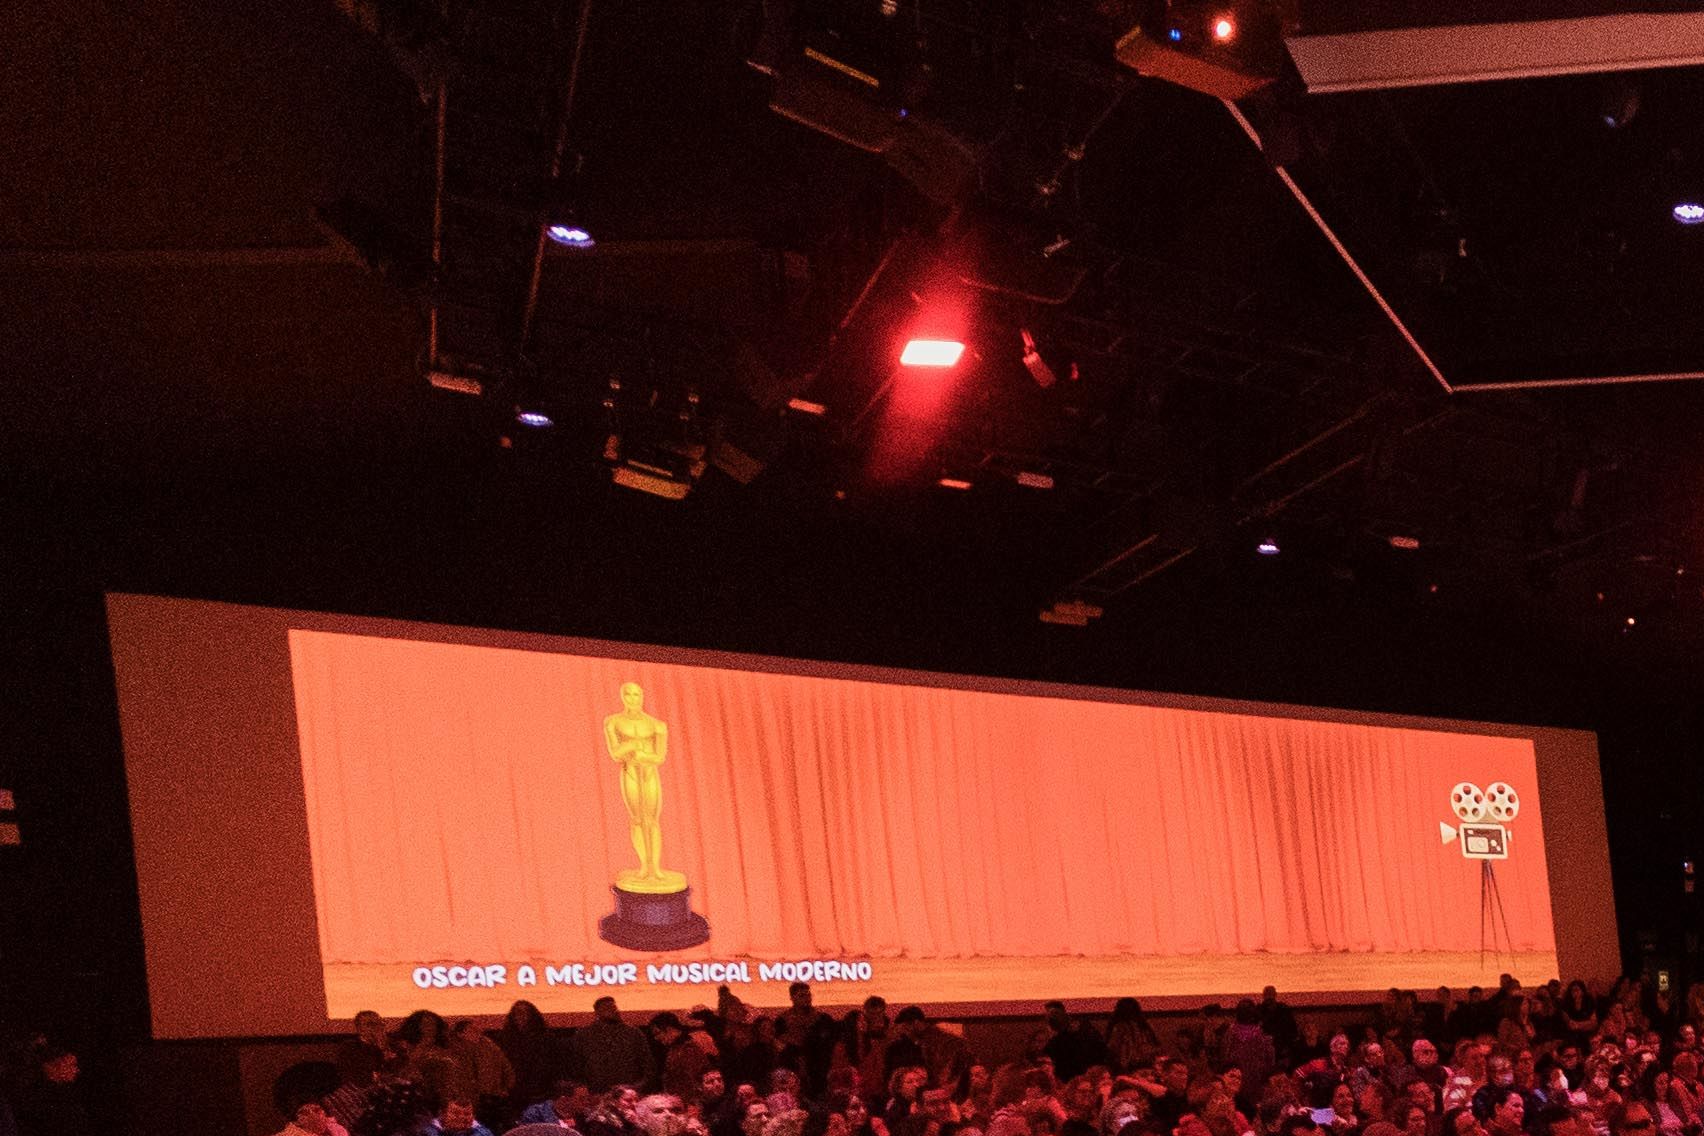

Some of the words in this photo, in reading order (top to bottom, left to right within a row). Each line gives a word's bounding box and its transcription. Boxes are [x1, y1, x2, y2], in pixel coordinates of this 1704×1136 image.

[412, 964, 507, 989] OSCAR
[517, 965, 537, 987] A
[545, 963, 638, 987] MEJOR
[646, 961, 752, 984] MUSICAL
[759, 960, 873, 982] MODERNO
